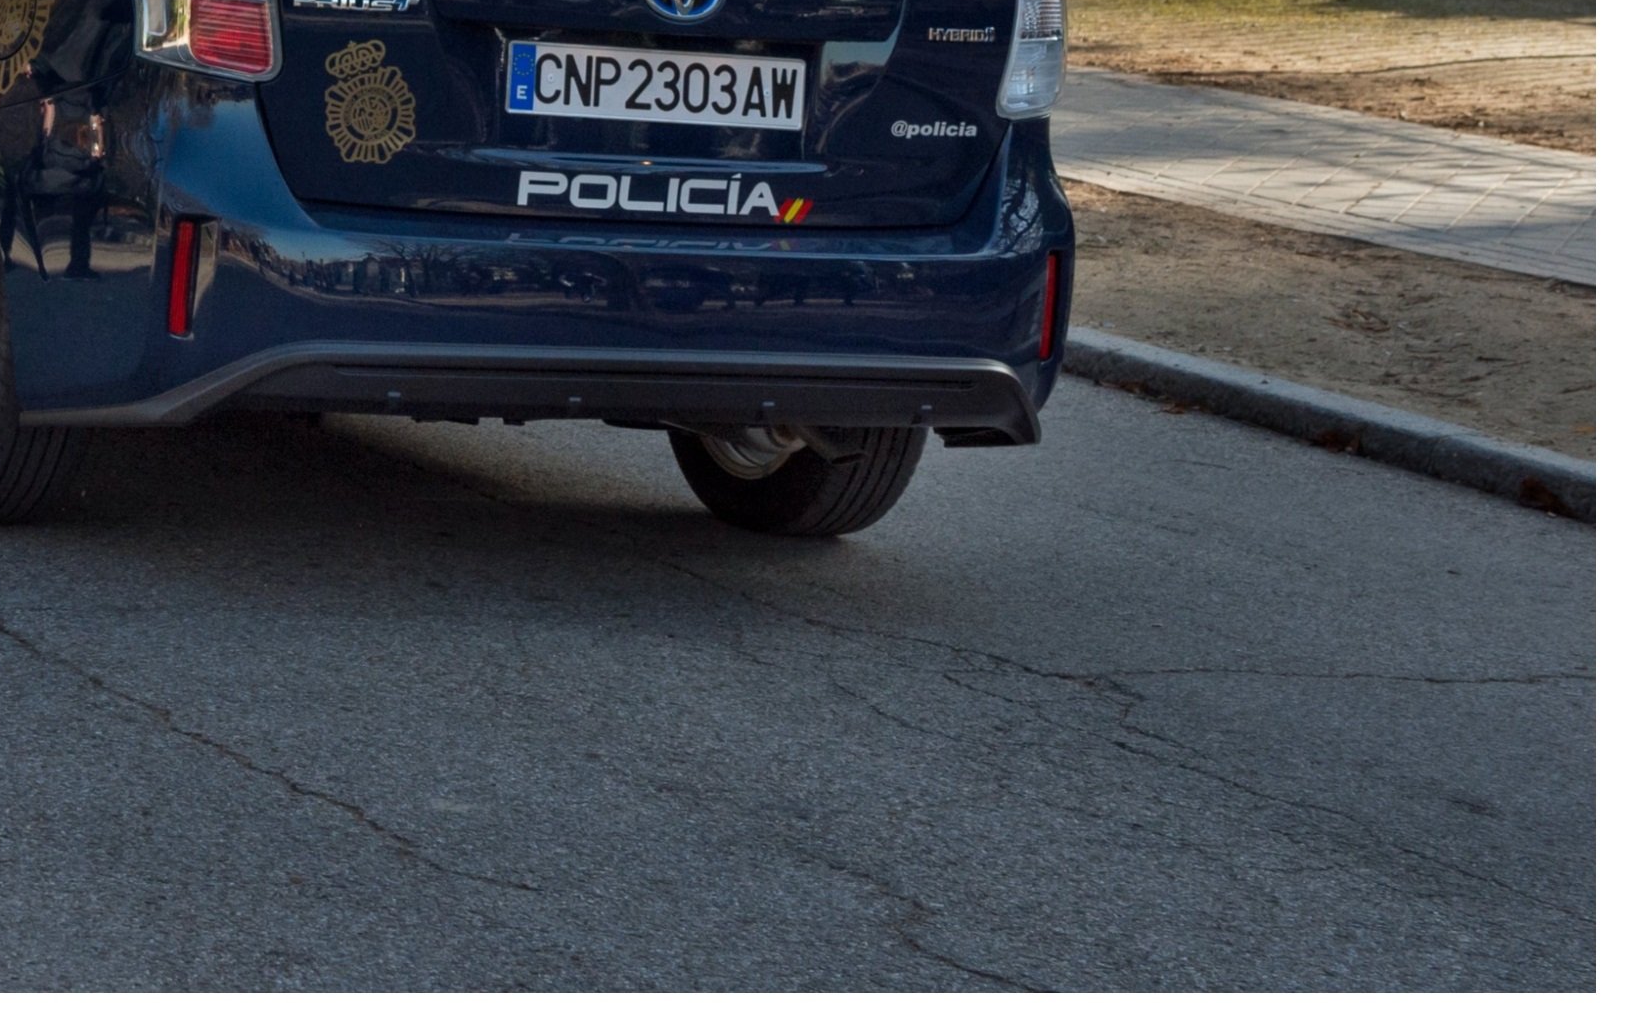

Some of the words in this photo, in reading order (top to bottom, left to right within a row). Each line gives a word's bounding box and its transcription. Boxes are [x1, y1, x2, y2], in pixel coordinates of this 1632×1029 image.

[928, 26, 986, 43] HYBRID
[516, 84, 528, 100] E
[891, 120, 978, 139] @policia
[517, 171, 780, 217] POLICÍA
